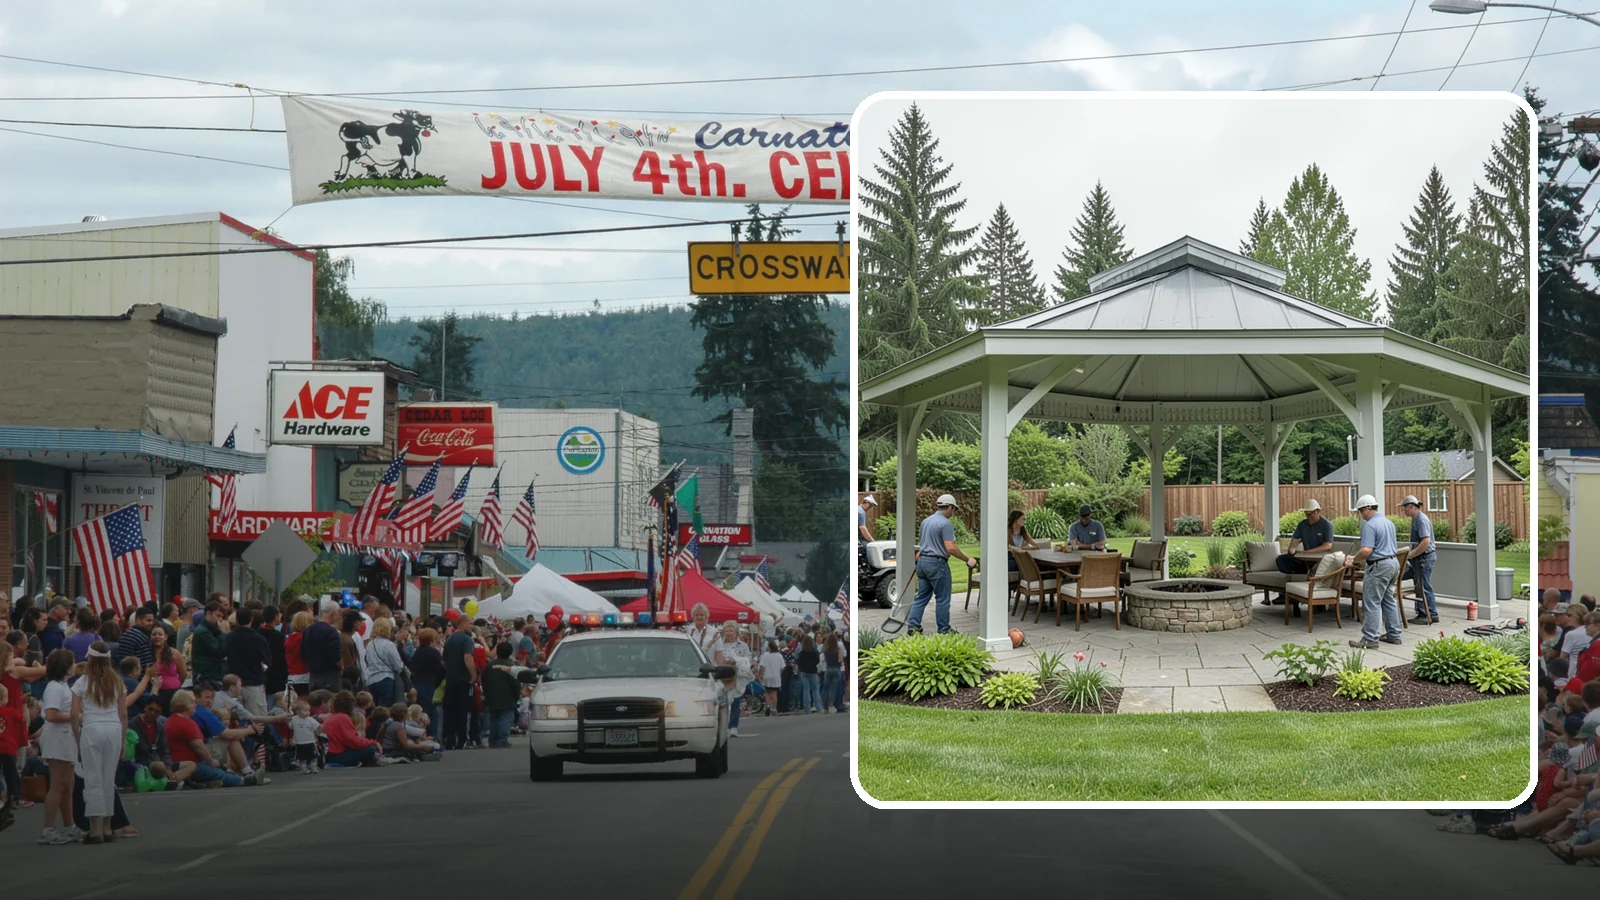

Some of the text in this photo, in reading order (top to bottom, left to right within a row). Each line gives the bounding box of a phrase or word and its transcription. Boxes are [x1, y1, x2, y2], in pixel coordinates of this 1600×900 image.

[481, 141, 605, 192] JULY
[632, 150, 746, 198] 4th.
[283, 380, 374, 420] ACE
[406, 409, 452, 422] CEDAR
[283, 421, 371, 436] Hardware
[416, 428, 477, 447] Coca-Cola
[83, 485, 155, 495] St. Vincent de Paul
[699, 535, 730, 543] GLASS
